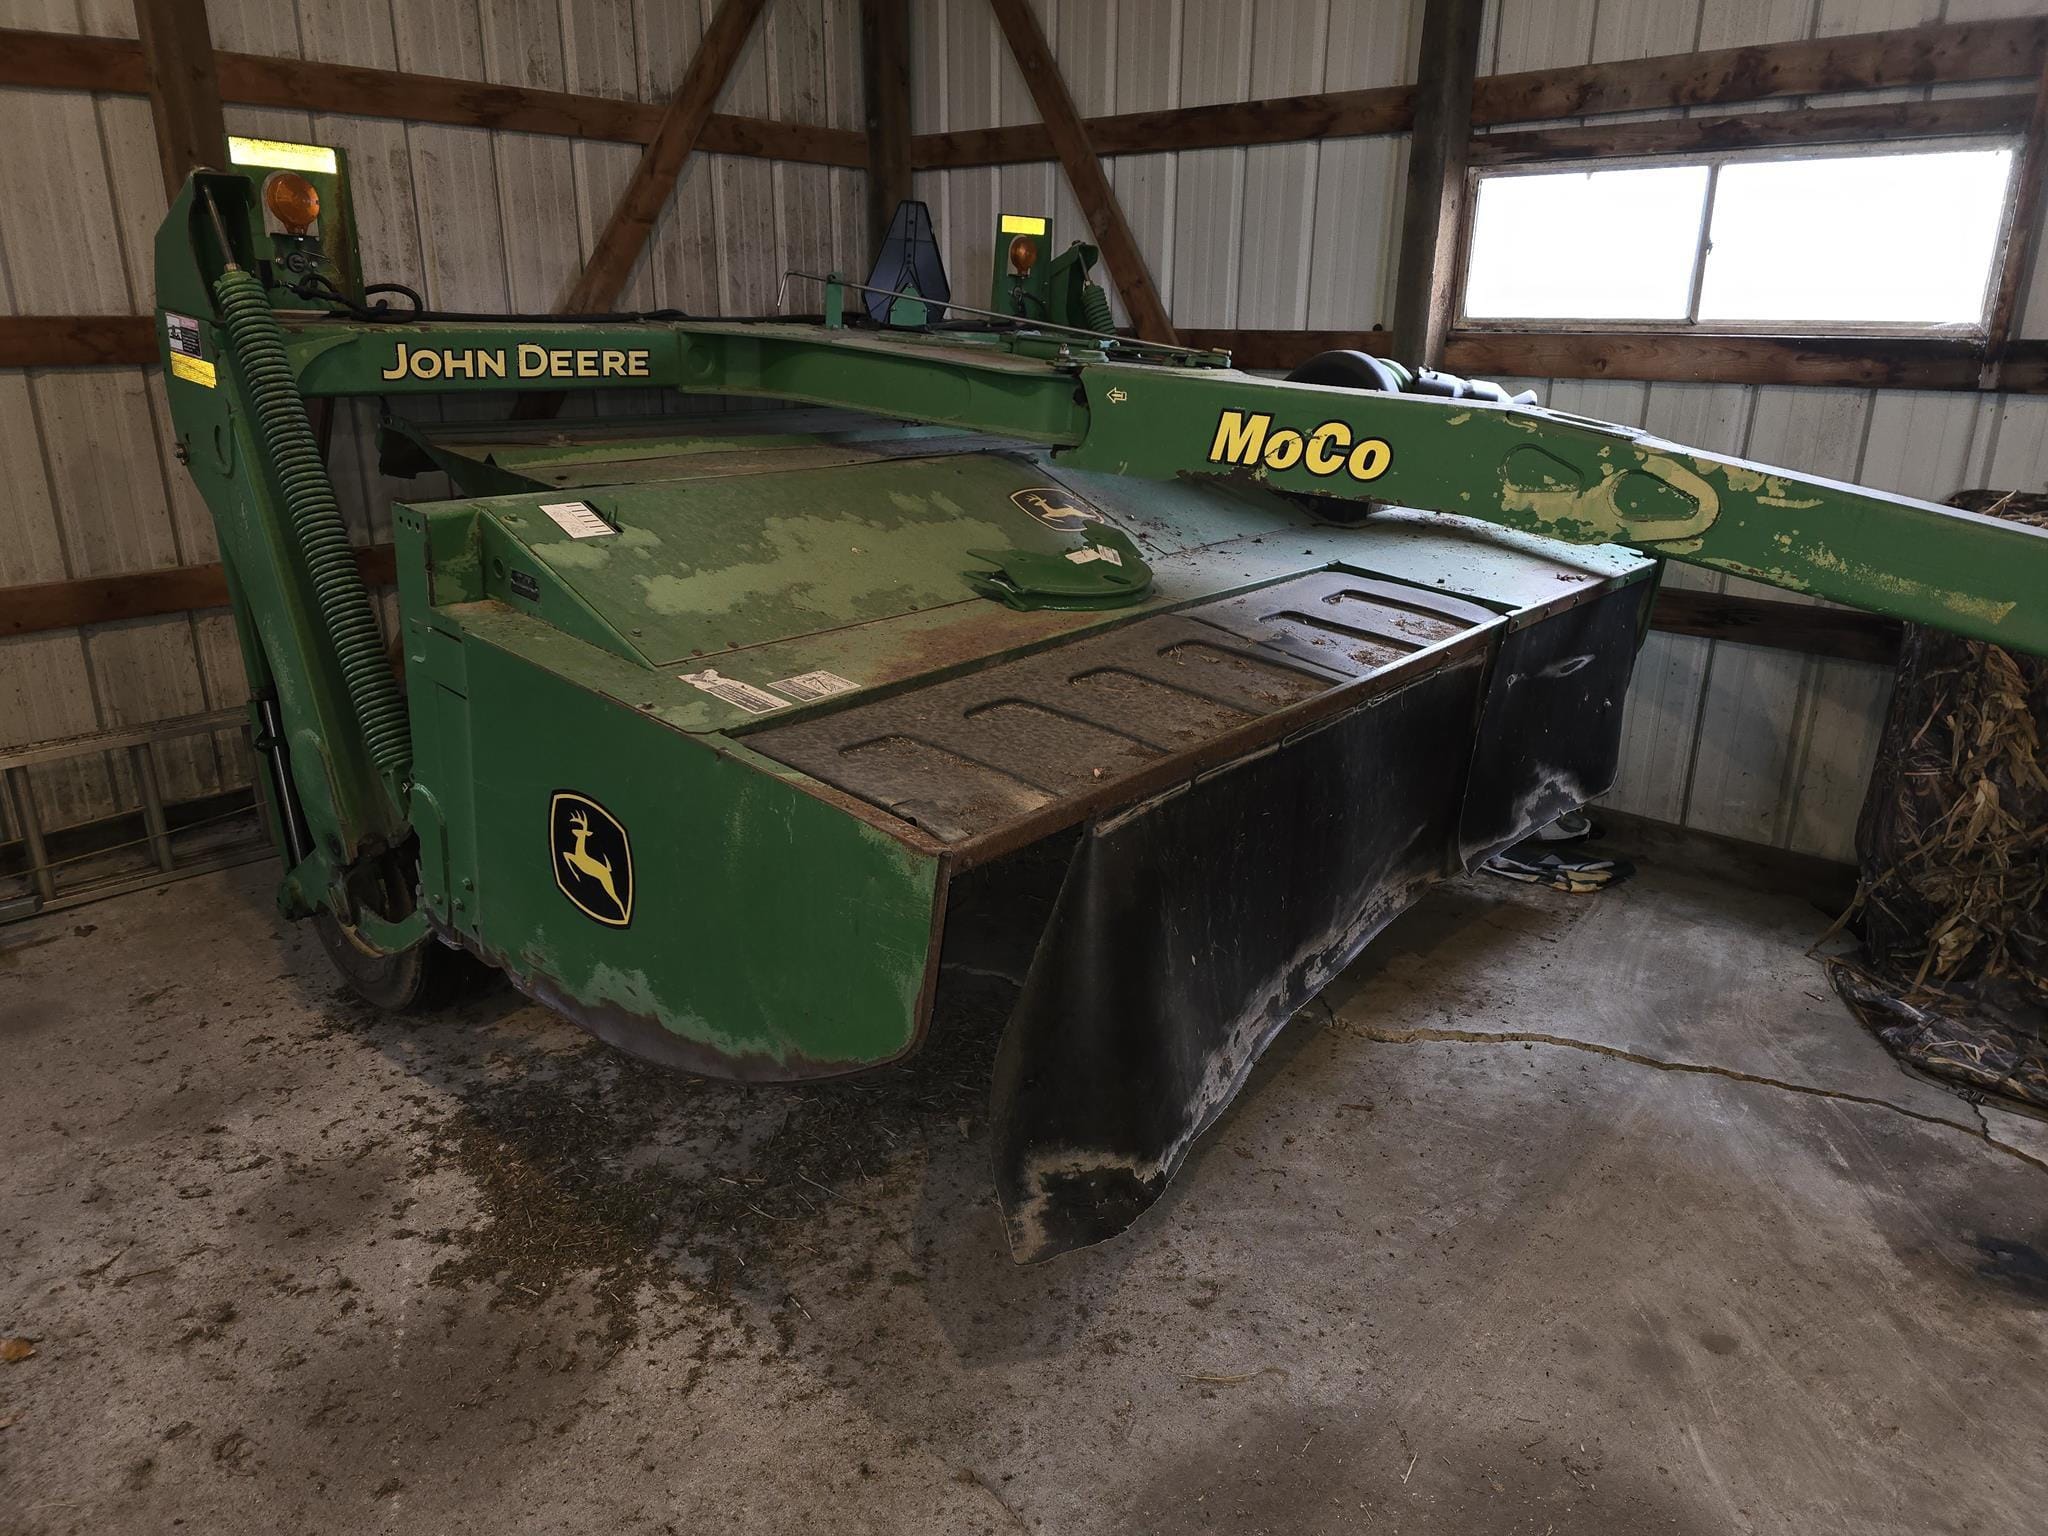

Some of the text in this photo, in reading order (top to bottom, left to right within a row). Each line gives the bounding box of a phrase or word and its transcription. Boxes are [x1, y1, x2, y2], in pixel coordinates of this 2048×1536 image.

[382, 342, 650, 380] JOHN DEERE
[1209, 409, 1392, 482] MoCo
